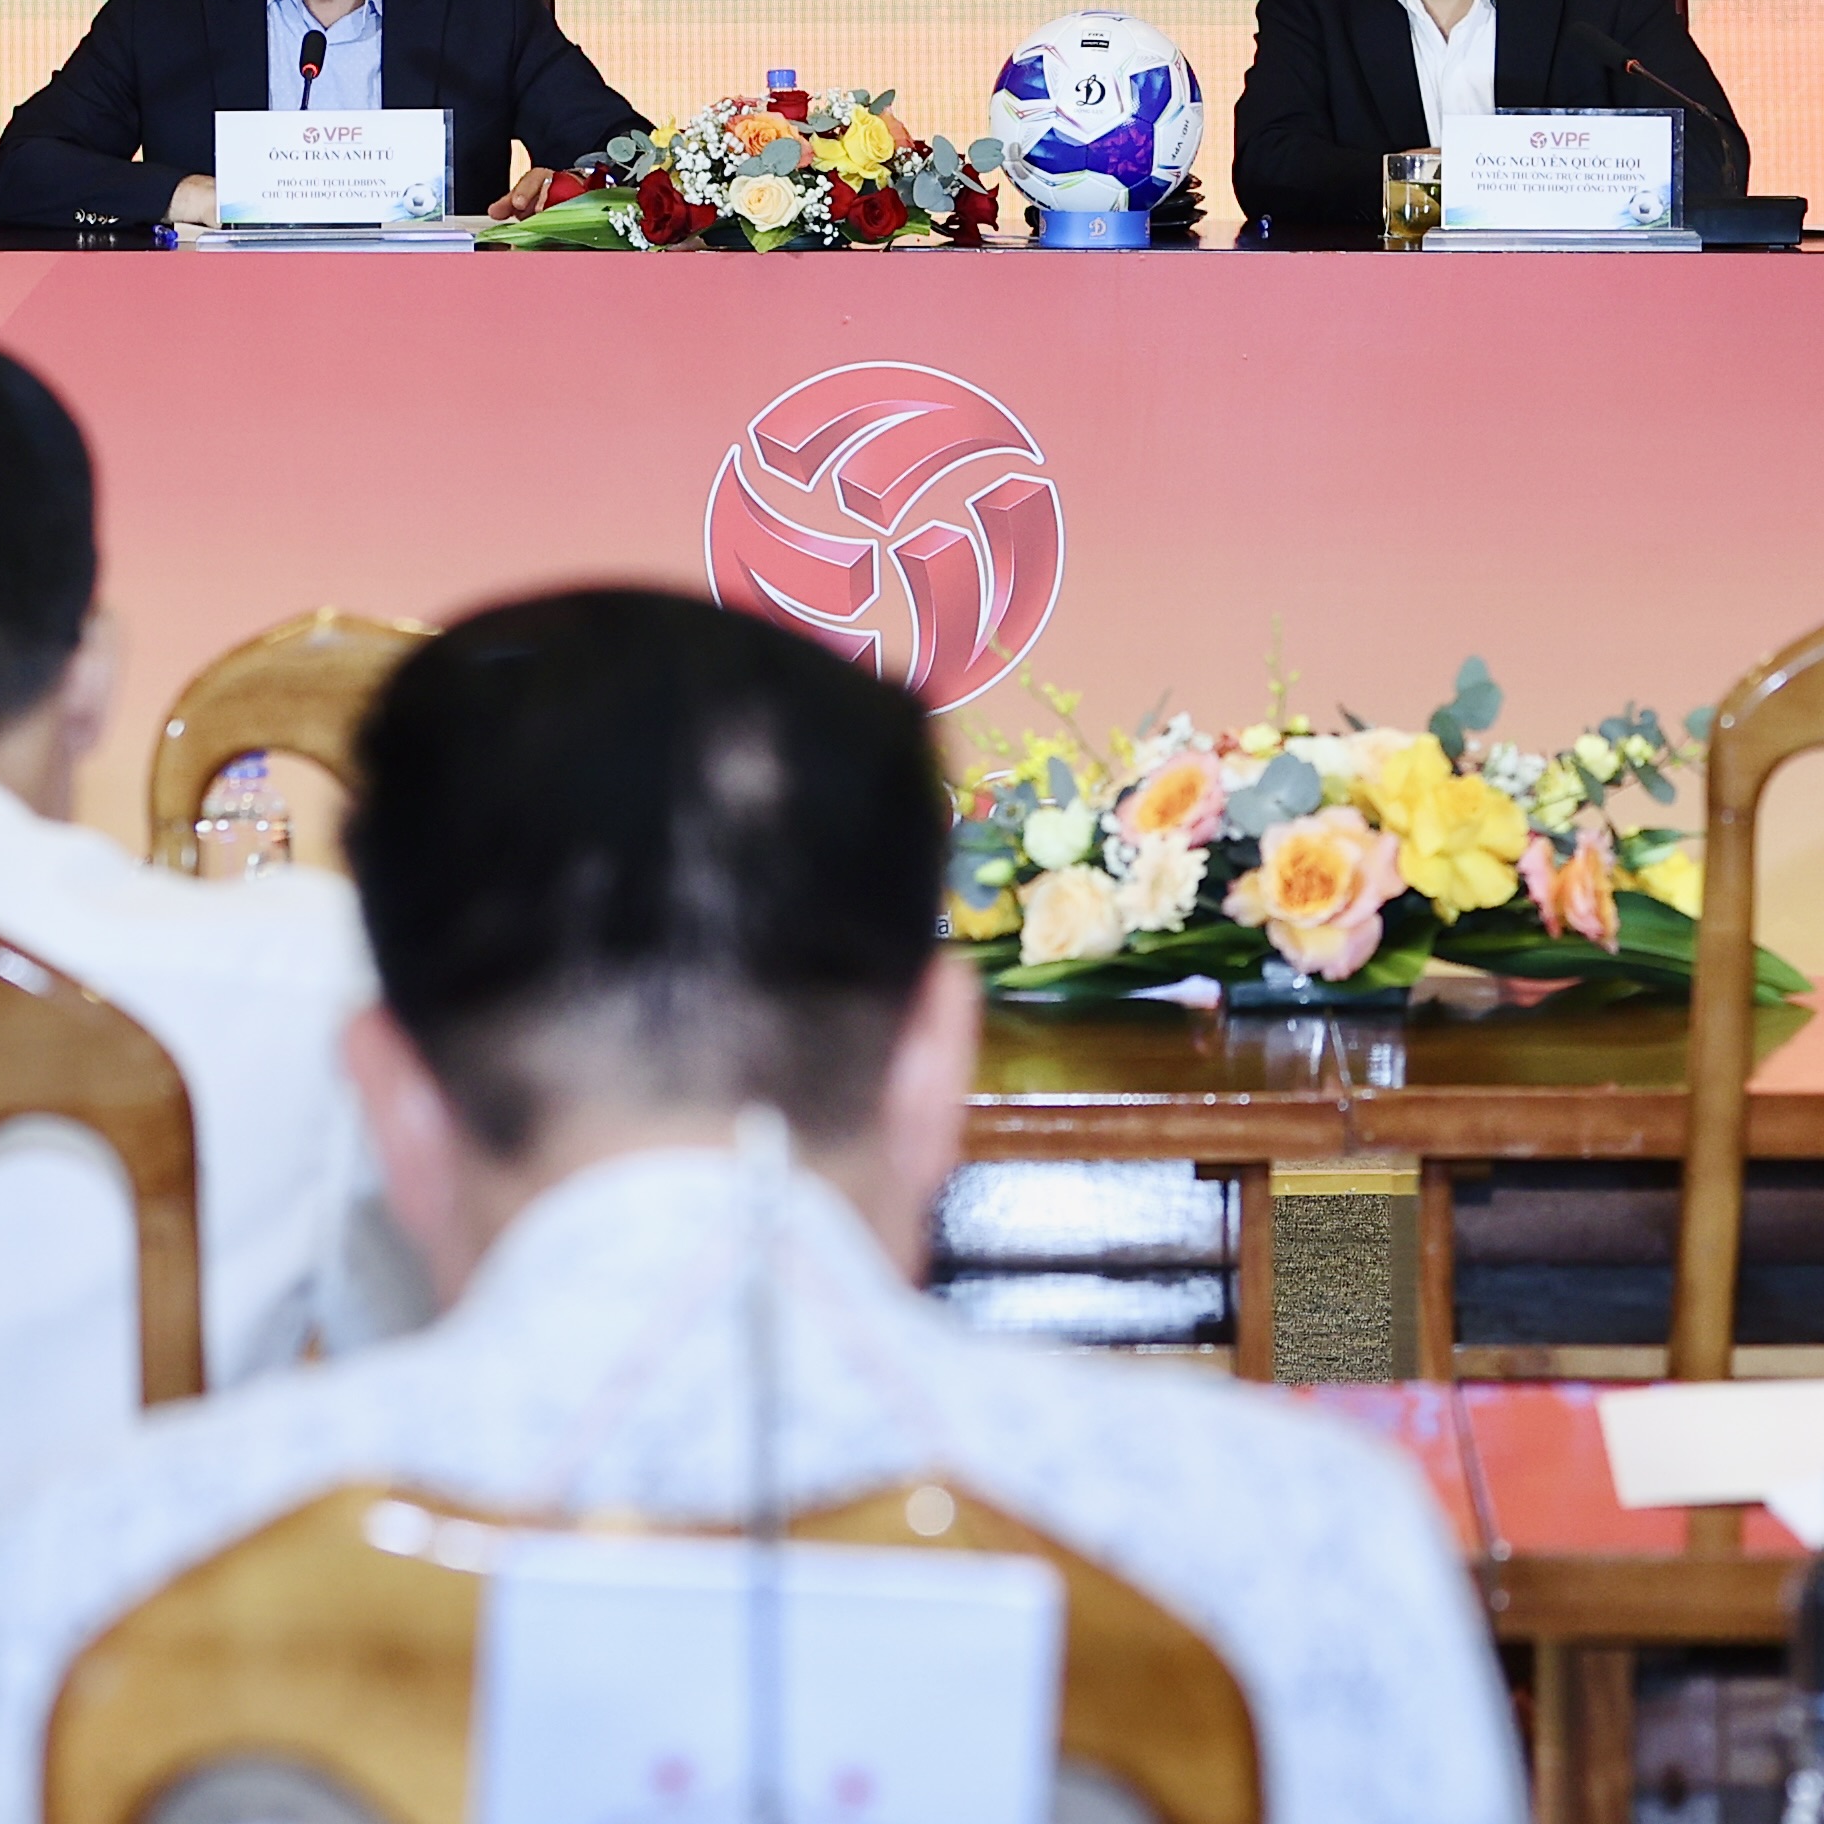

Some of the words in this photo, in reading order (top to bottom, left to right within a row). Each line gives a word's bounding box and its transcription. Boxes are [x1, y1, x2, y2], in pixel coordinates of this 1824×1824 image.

[323, 126, 363, 142] VPF
[1550, 131, 1590, 147] VPF
[269, 146, 299, 161] ÔNG
[343, 150, 372, 161] ANH
[375, 146, 394, 161] TÚ
[1475, 152, 1506, 167] ÔNG
